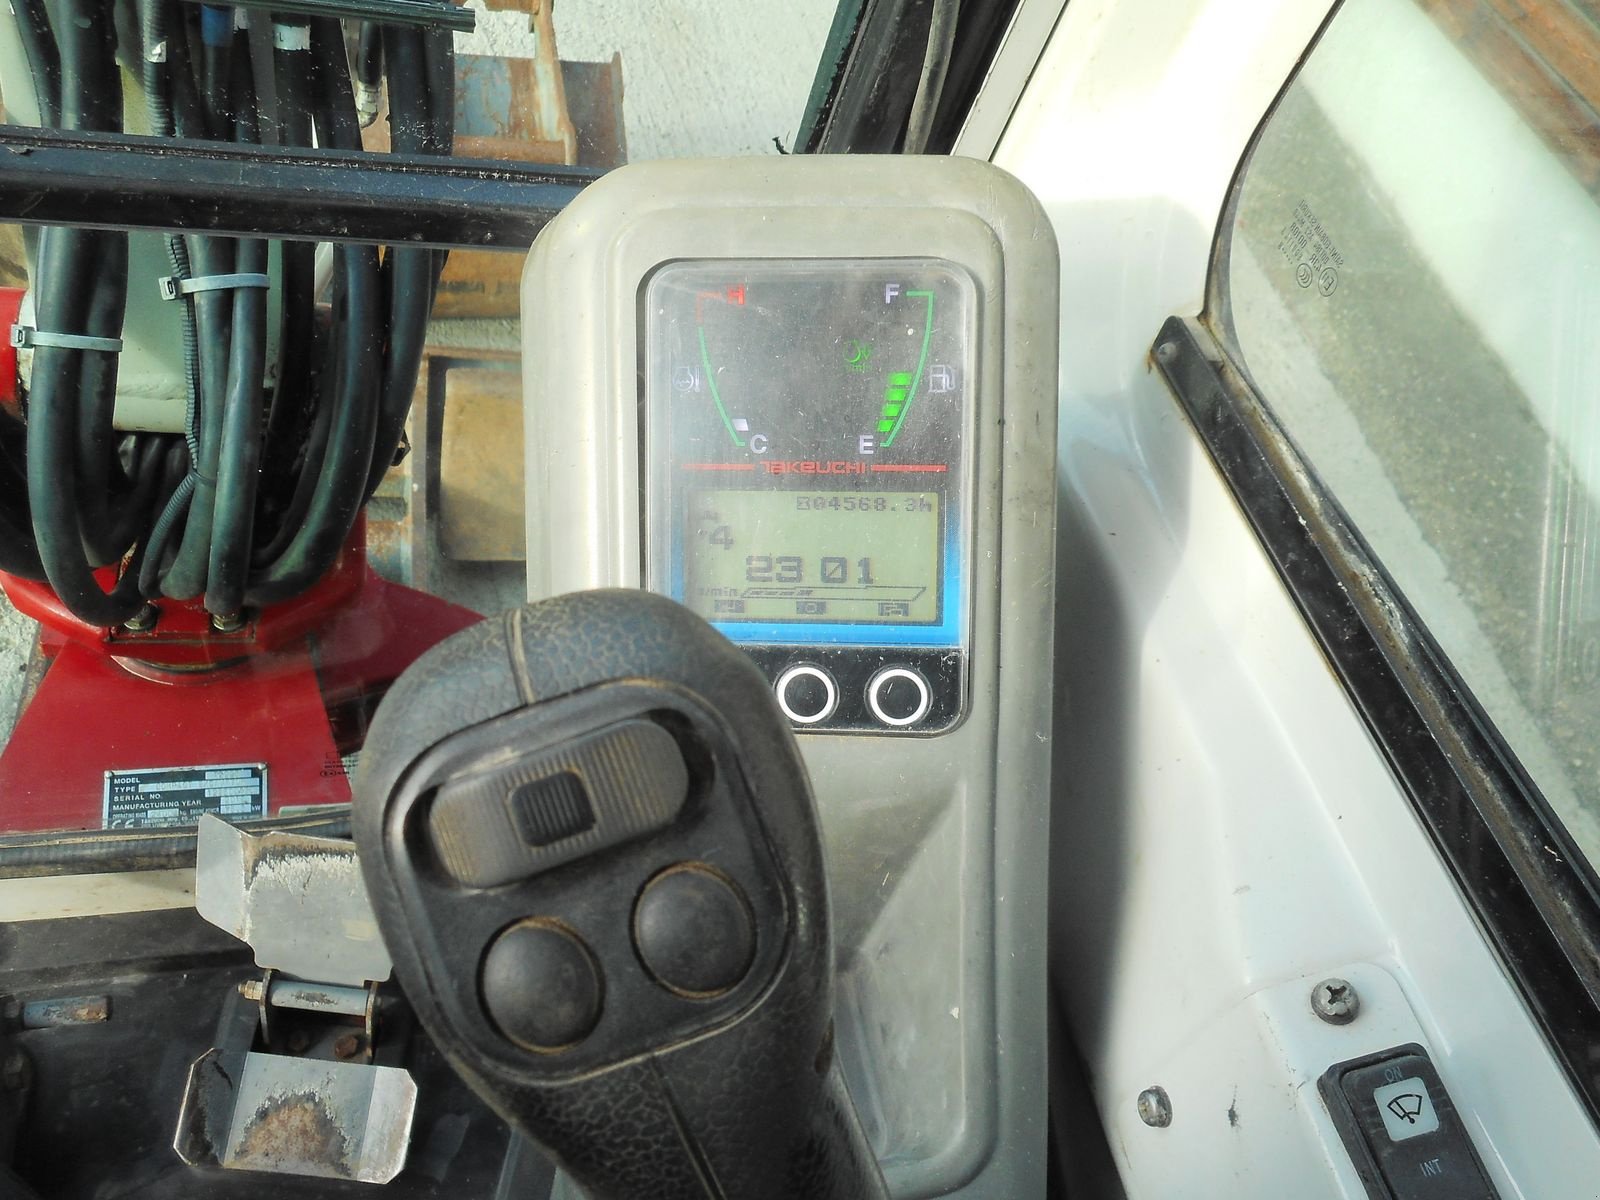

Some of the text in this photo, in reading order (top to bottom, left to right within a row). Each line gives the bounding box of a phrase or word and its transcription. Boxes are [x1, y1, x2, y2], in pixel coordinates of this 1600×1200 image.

[727, 284, 746, 305] H
[885, 283, 900, 304] F
[750, 434, 769, 455] C
[858, 435, 875, 455] E
[709, 525, 734, 551] 4
[114, 777, 141, 785] MODEL
[114, 785, 136, 793] TYPE
[112, 799, 202, 812] MANUFACTURING YEAR
[113, 795, 145, 803] SERIAL
[1384, 1066, 1404, 1083] ON
[1419, 1158, 1443, 1178] INT
